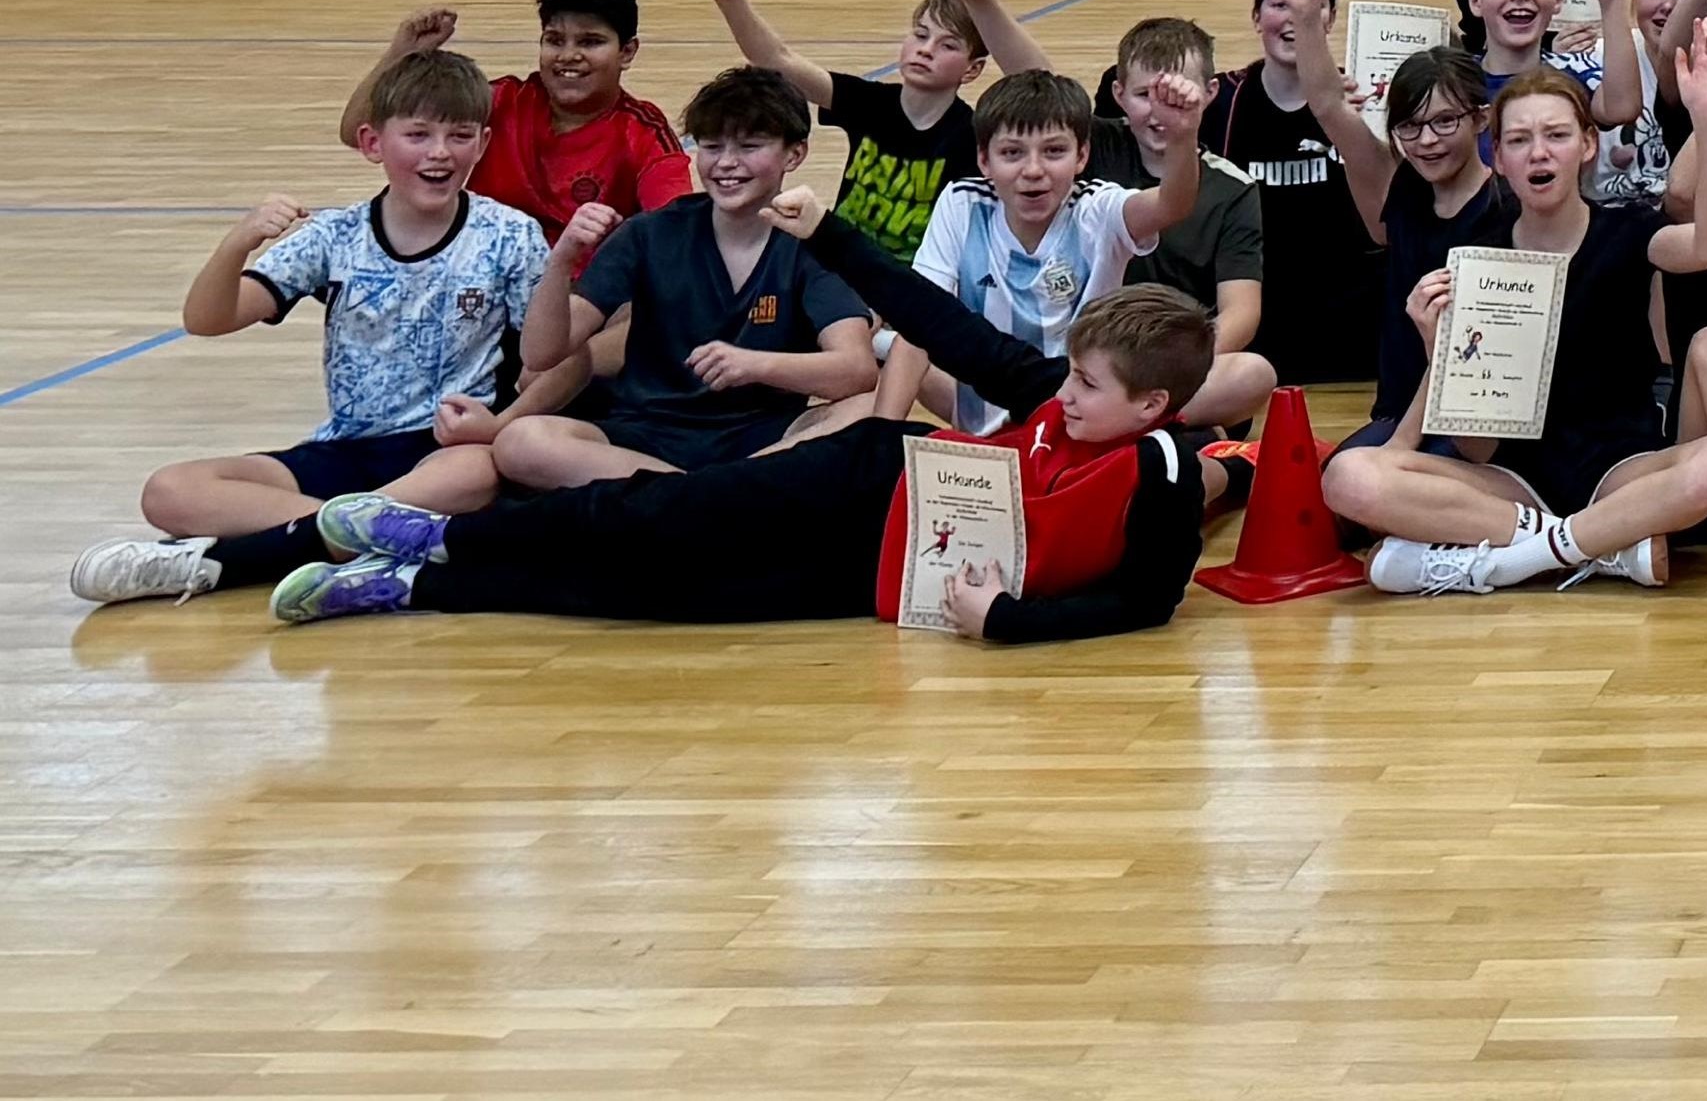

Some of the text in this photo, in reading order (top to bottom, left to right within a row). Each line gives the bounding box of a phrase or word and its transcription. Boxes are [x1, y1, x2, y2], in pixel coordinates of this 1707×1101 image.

[845, 137, 946, 201] RAIN
[1248, 157, 1328, 186] PUMA
[1479, 277, 1535, 294] Urkunde
[937, 471, 993, 490] Urkunde
